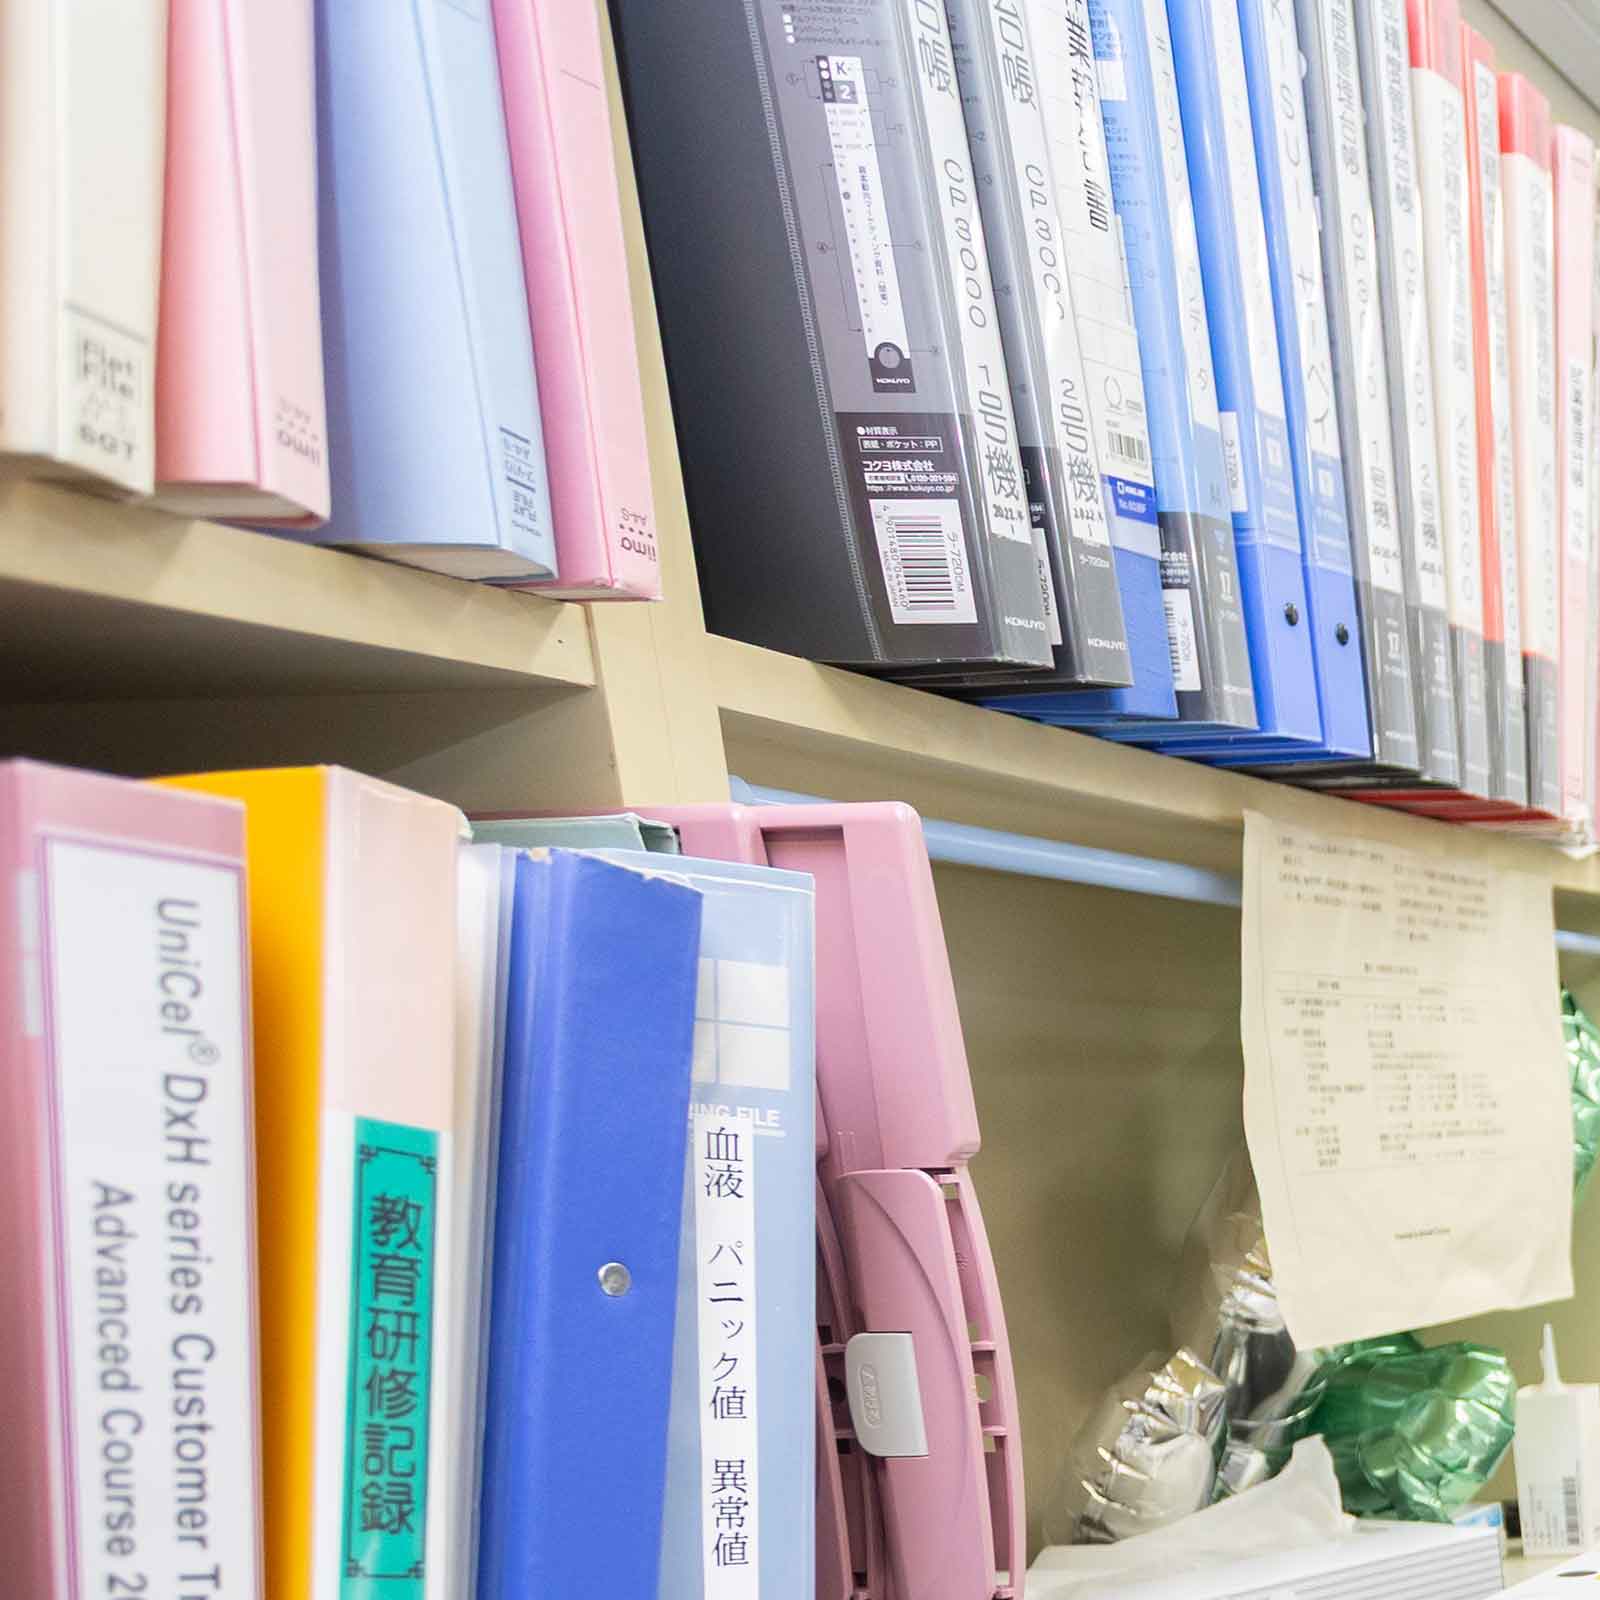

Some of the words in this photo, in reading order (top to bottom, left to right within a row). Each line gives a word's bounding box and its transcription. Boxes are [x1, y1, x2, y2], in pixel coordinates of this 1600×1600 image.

[861, 459, 936, 473] コクヨ株式会社
[1003, 614, 1047, 632] KOKUYO
[161, 1072, 212, 1168] DxH
[704, 1126, 744, 1199] 血液
[90, 1180, 142, 1393] Advanced
[165, 1181, 213, 1316] series
[360, 1193, 425, 1535] 教育研修記録
[706, 1240, 748, 1420] パニック値
[101, 1408, 144, 1558] Course
[170, 1333, 217, 1551] Customer
[711, 1458, 750, 1567] 異常値
